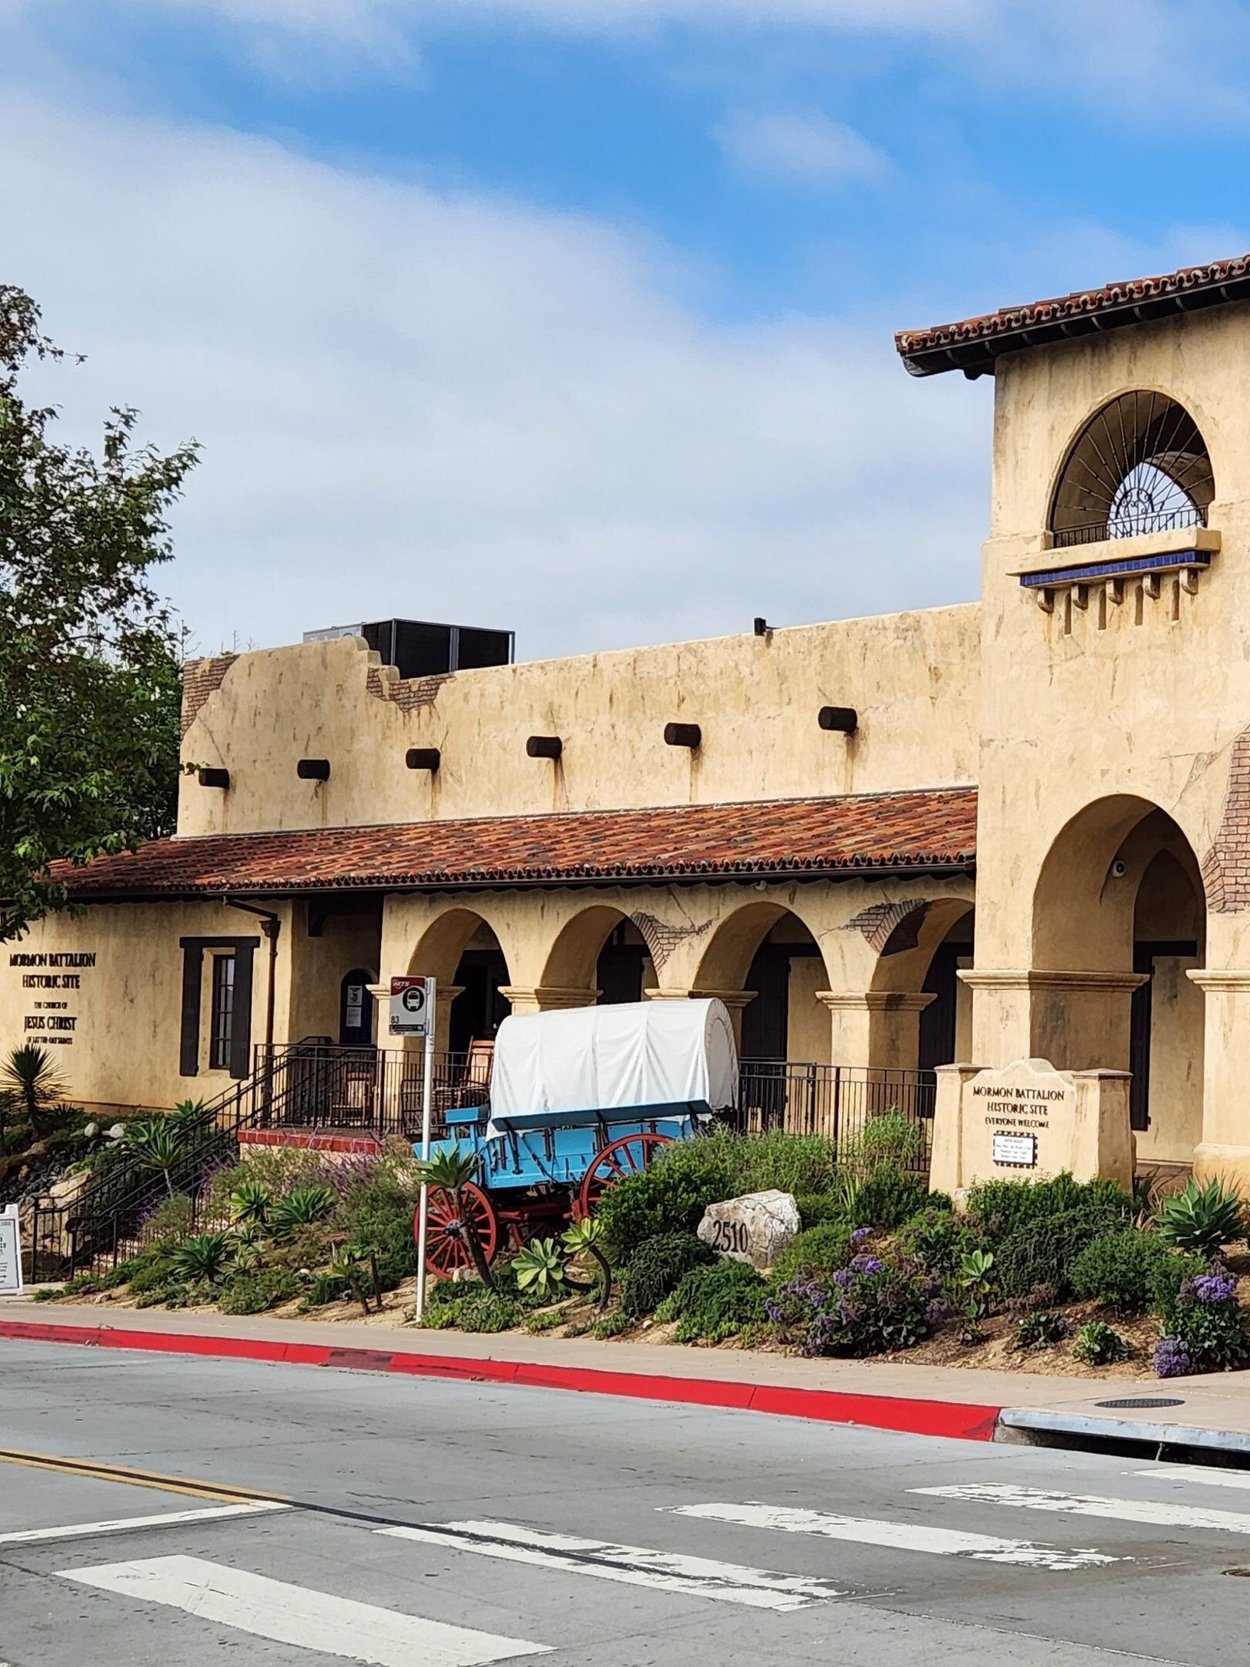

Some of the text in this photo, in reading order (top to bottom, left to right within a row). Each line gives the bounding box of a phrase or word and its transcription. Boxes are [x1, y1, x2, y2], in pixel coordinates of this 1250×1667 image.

[9, 953, 96, 967] MORMON BATTALION
[22, 974, 80, 989] HISTORIC SITE
[24, 1016, 77, 1033] JESUS CHRIST
[391, 1015, 399, 1024] 83
[973, 1086, 1065, 1100] MORMON BATTALION
[987, 1102, 1048, 1115] HISTORIC SITE
[985, 1117, 1049, 1128] EVERYONE WELCOME
[712, 1220, 748, 1253] 2510
